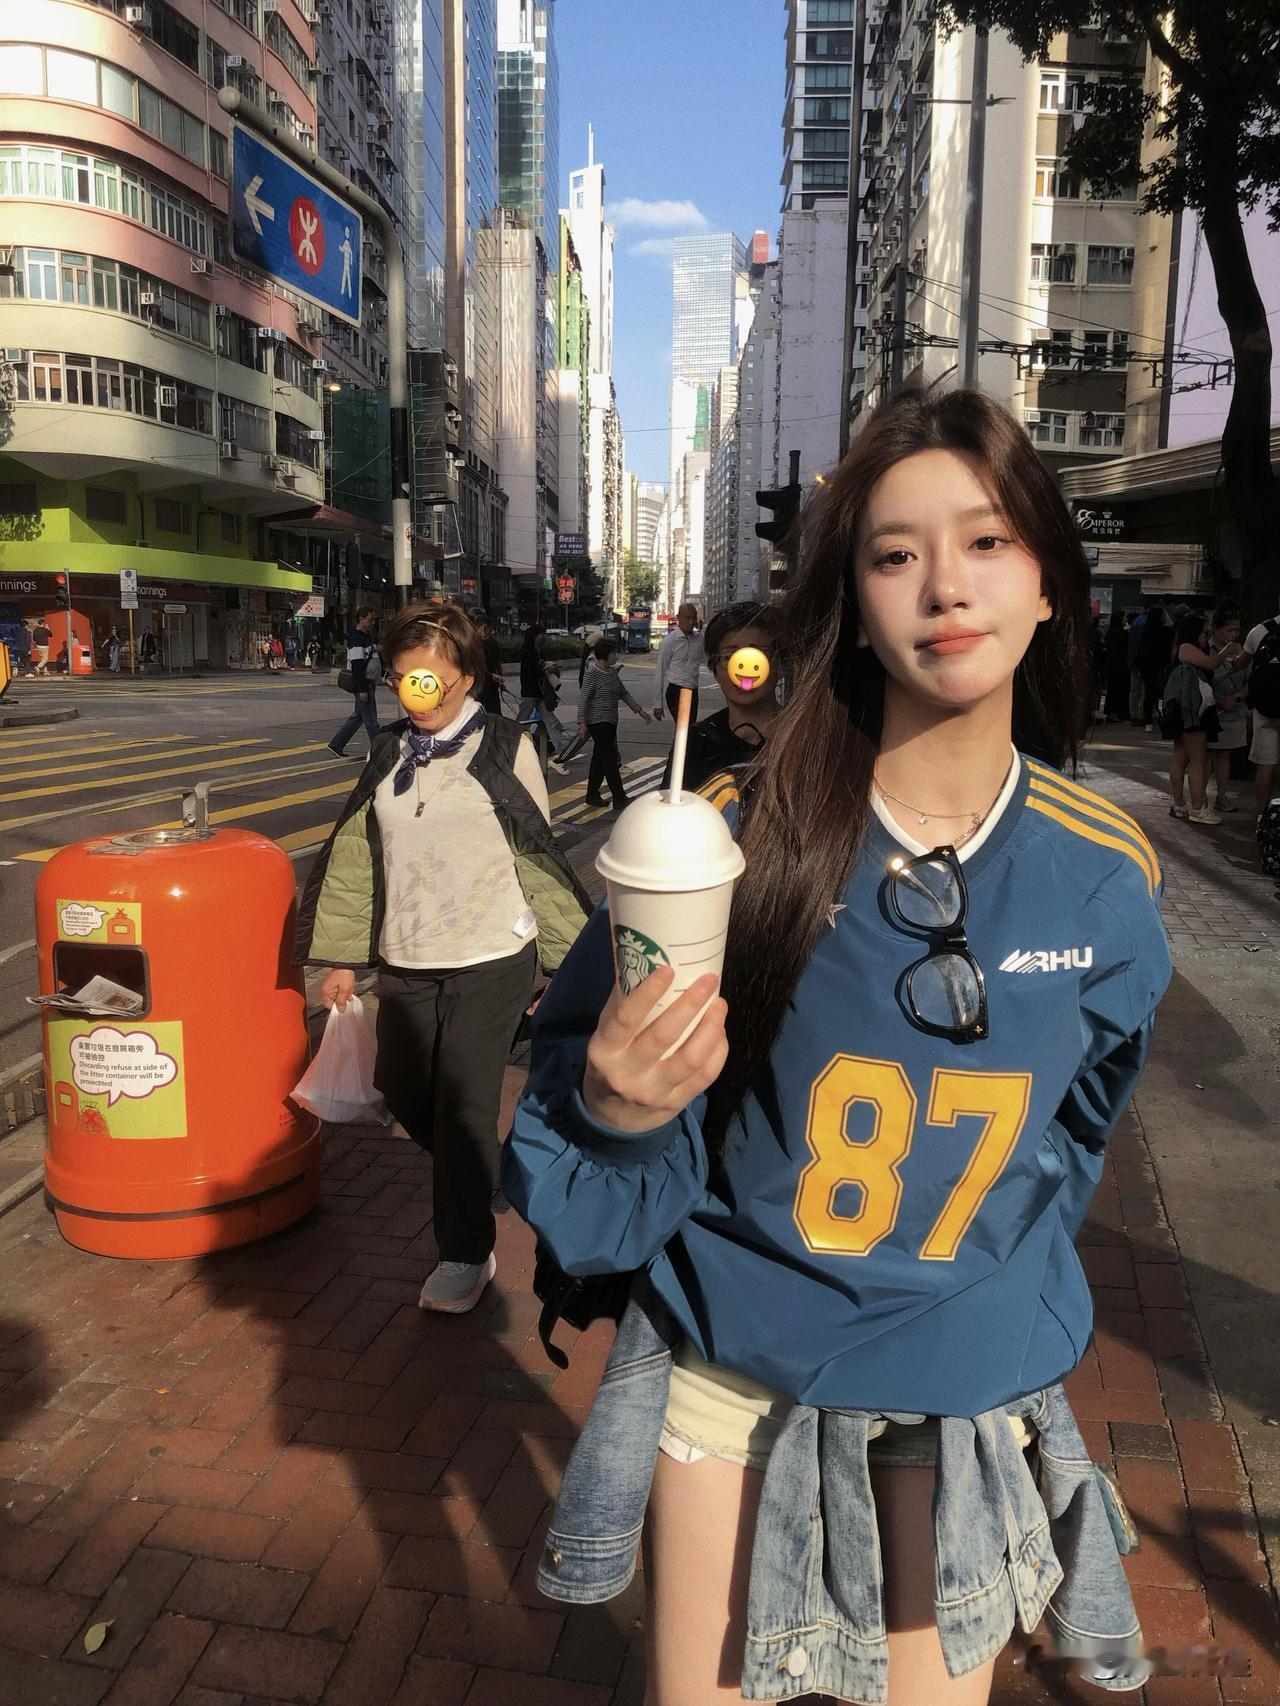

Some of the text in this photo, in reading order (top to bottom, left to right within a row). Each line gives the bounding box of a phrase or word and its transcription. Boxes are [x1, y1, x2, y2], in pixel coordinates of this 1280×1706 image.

[1077, 509, 1124, 529] EMPEROR
[558, 535, 584, 543] Bestco
[80, 1061, 109, 1071] Discarding
[793, 1053, 1032, 1261] 87
